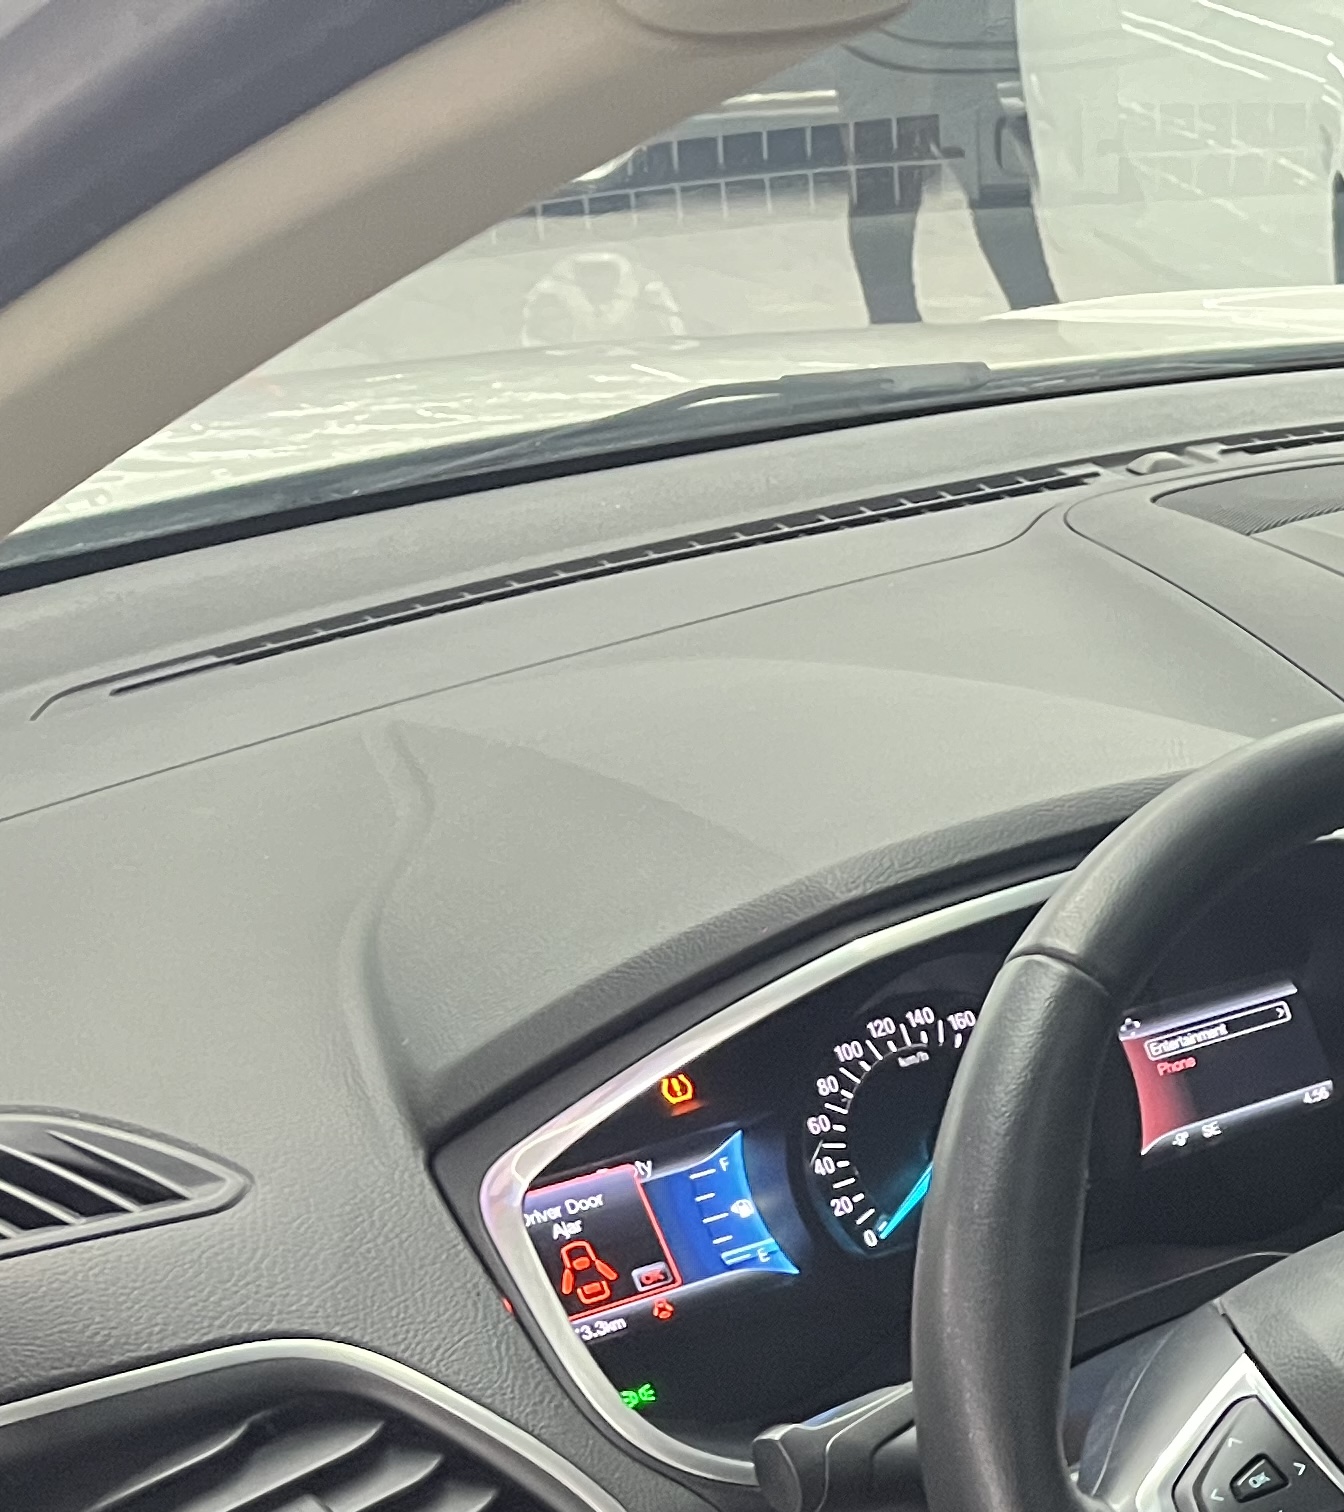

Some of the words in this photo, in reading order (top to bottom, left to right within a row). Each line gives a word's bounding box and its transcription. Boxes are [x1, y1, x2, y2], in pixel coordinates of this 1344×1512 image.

[866, 1017, 896, 1038] 120
[905, 1007, 935, 1027] 140
[947, 1010, 977, 1031] 160
[1149, 1023, 1229, 1056] Entertainment
[834, 1040, 864, 1062] 100
[1157, 1056, 1197, 1076] Phone
[816, 1075, 839, 1096] 80
[807, 1114, 831, 1135] 60
[814, 1156, 836, 1176] 40
[564, 1193, 604, 1215] Door
[830, 1195, 853, 1217] 20
[552, 1218, 583, 1240] Ajar
[863, 1229, 878, 1248] 0
[574, 1317, 628, 1342] 3.3km
